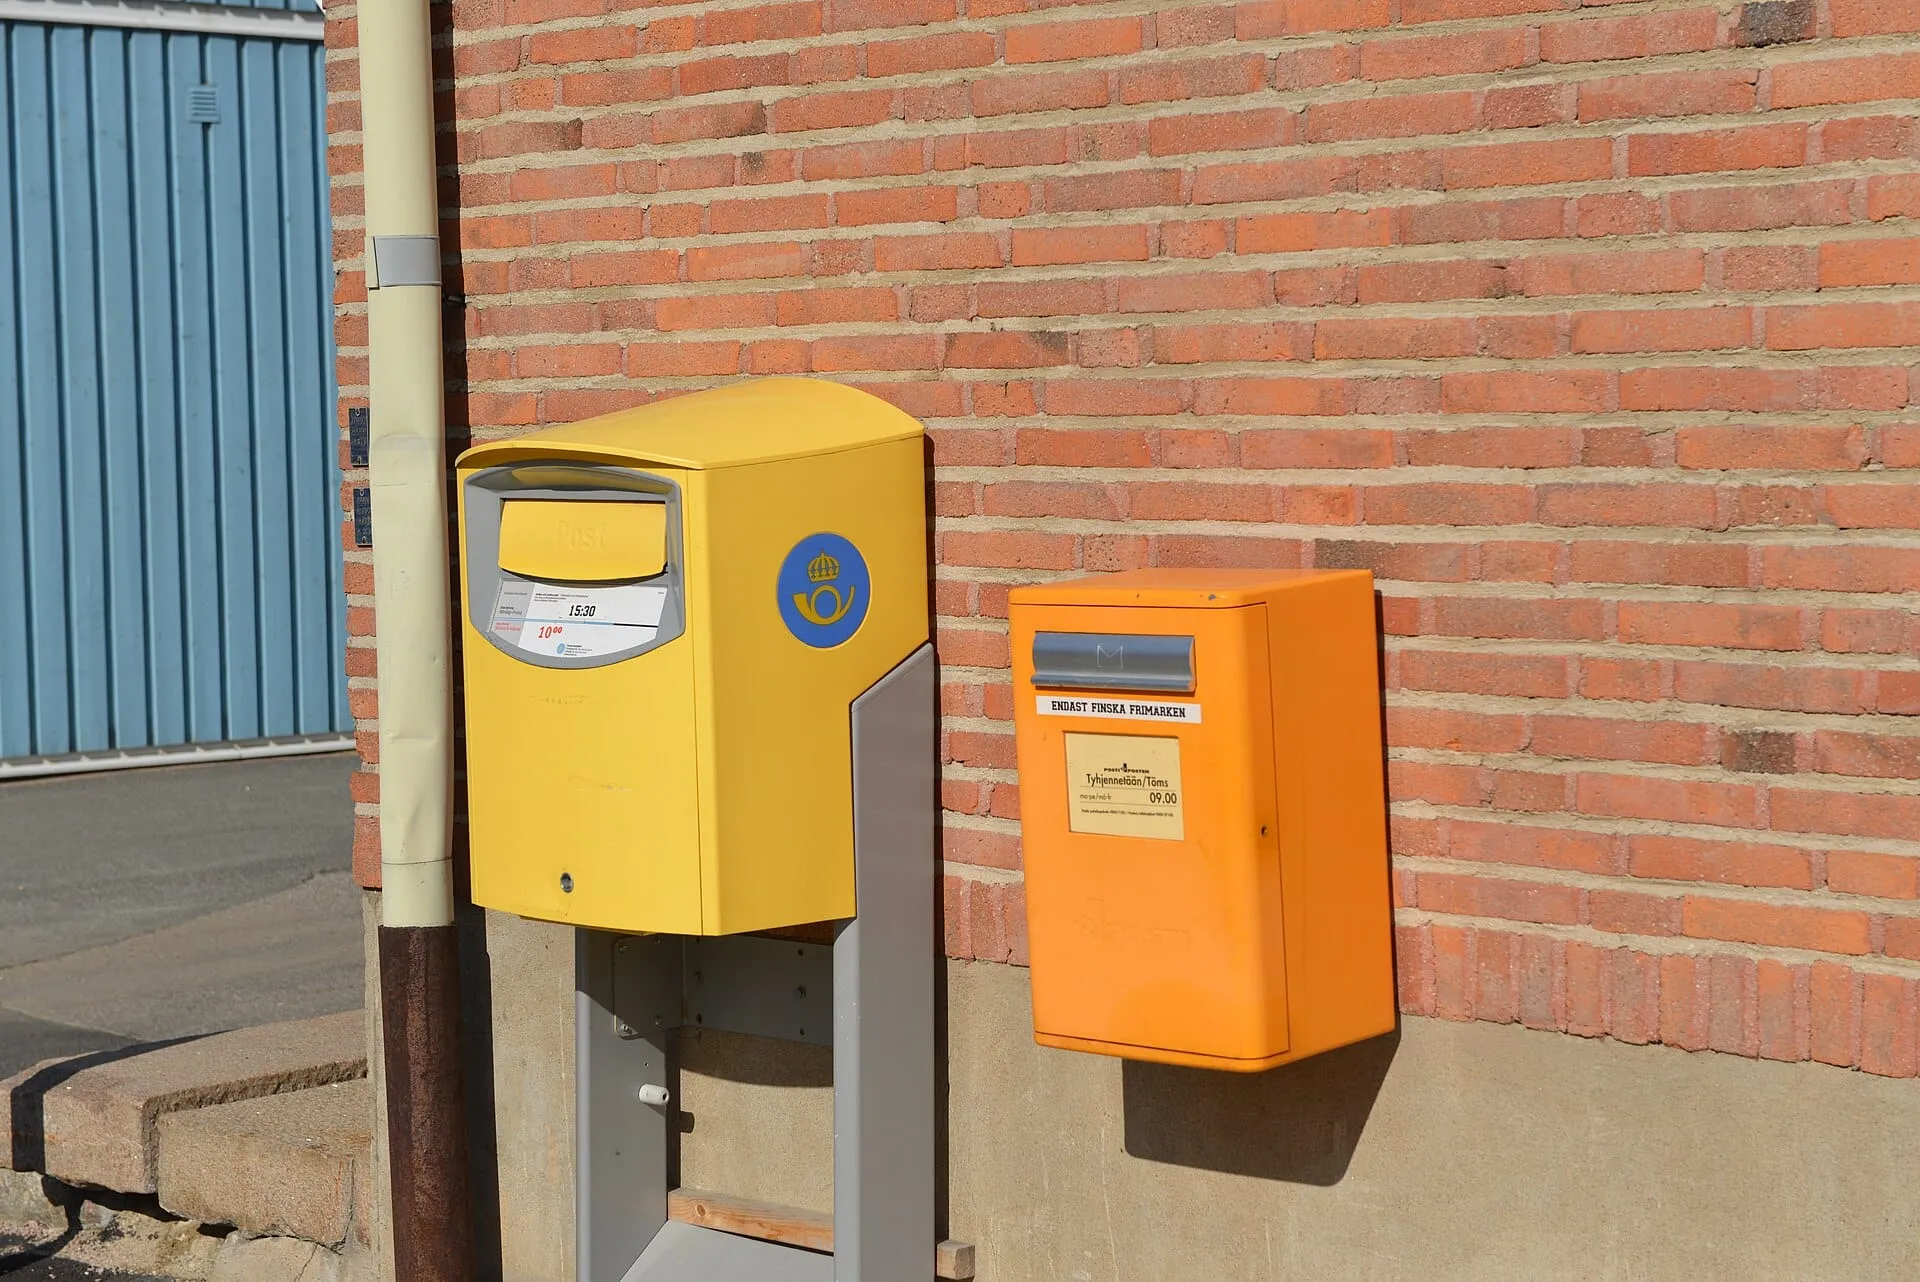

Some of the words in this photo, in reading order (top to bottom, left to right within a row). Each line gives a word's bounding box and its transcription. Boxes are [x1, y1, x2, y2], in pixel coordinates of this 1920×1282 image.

[569, 605, 596, 617] 15:30
[1051, 700, 1088, 712] ENDAST
[1091, 702, 1126, 714] FINSKA
[1130, 704, 1186, 717] FRIMARKEN
[1086, 772, 1169, 788] Tyhjennetään/Töms
[1149, 792, 1177, 804] 09.00
